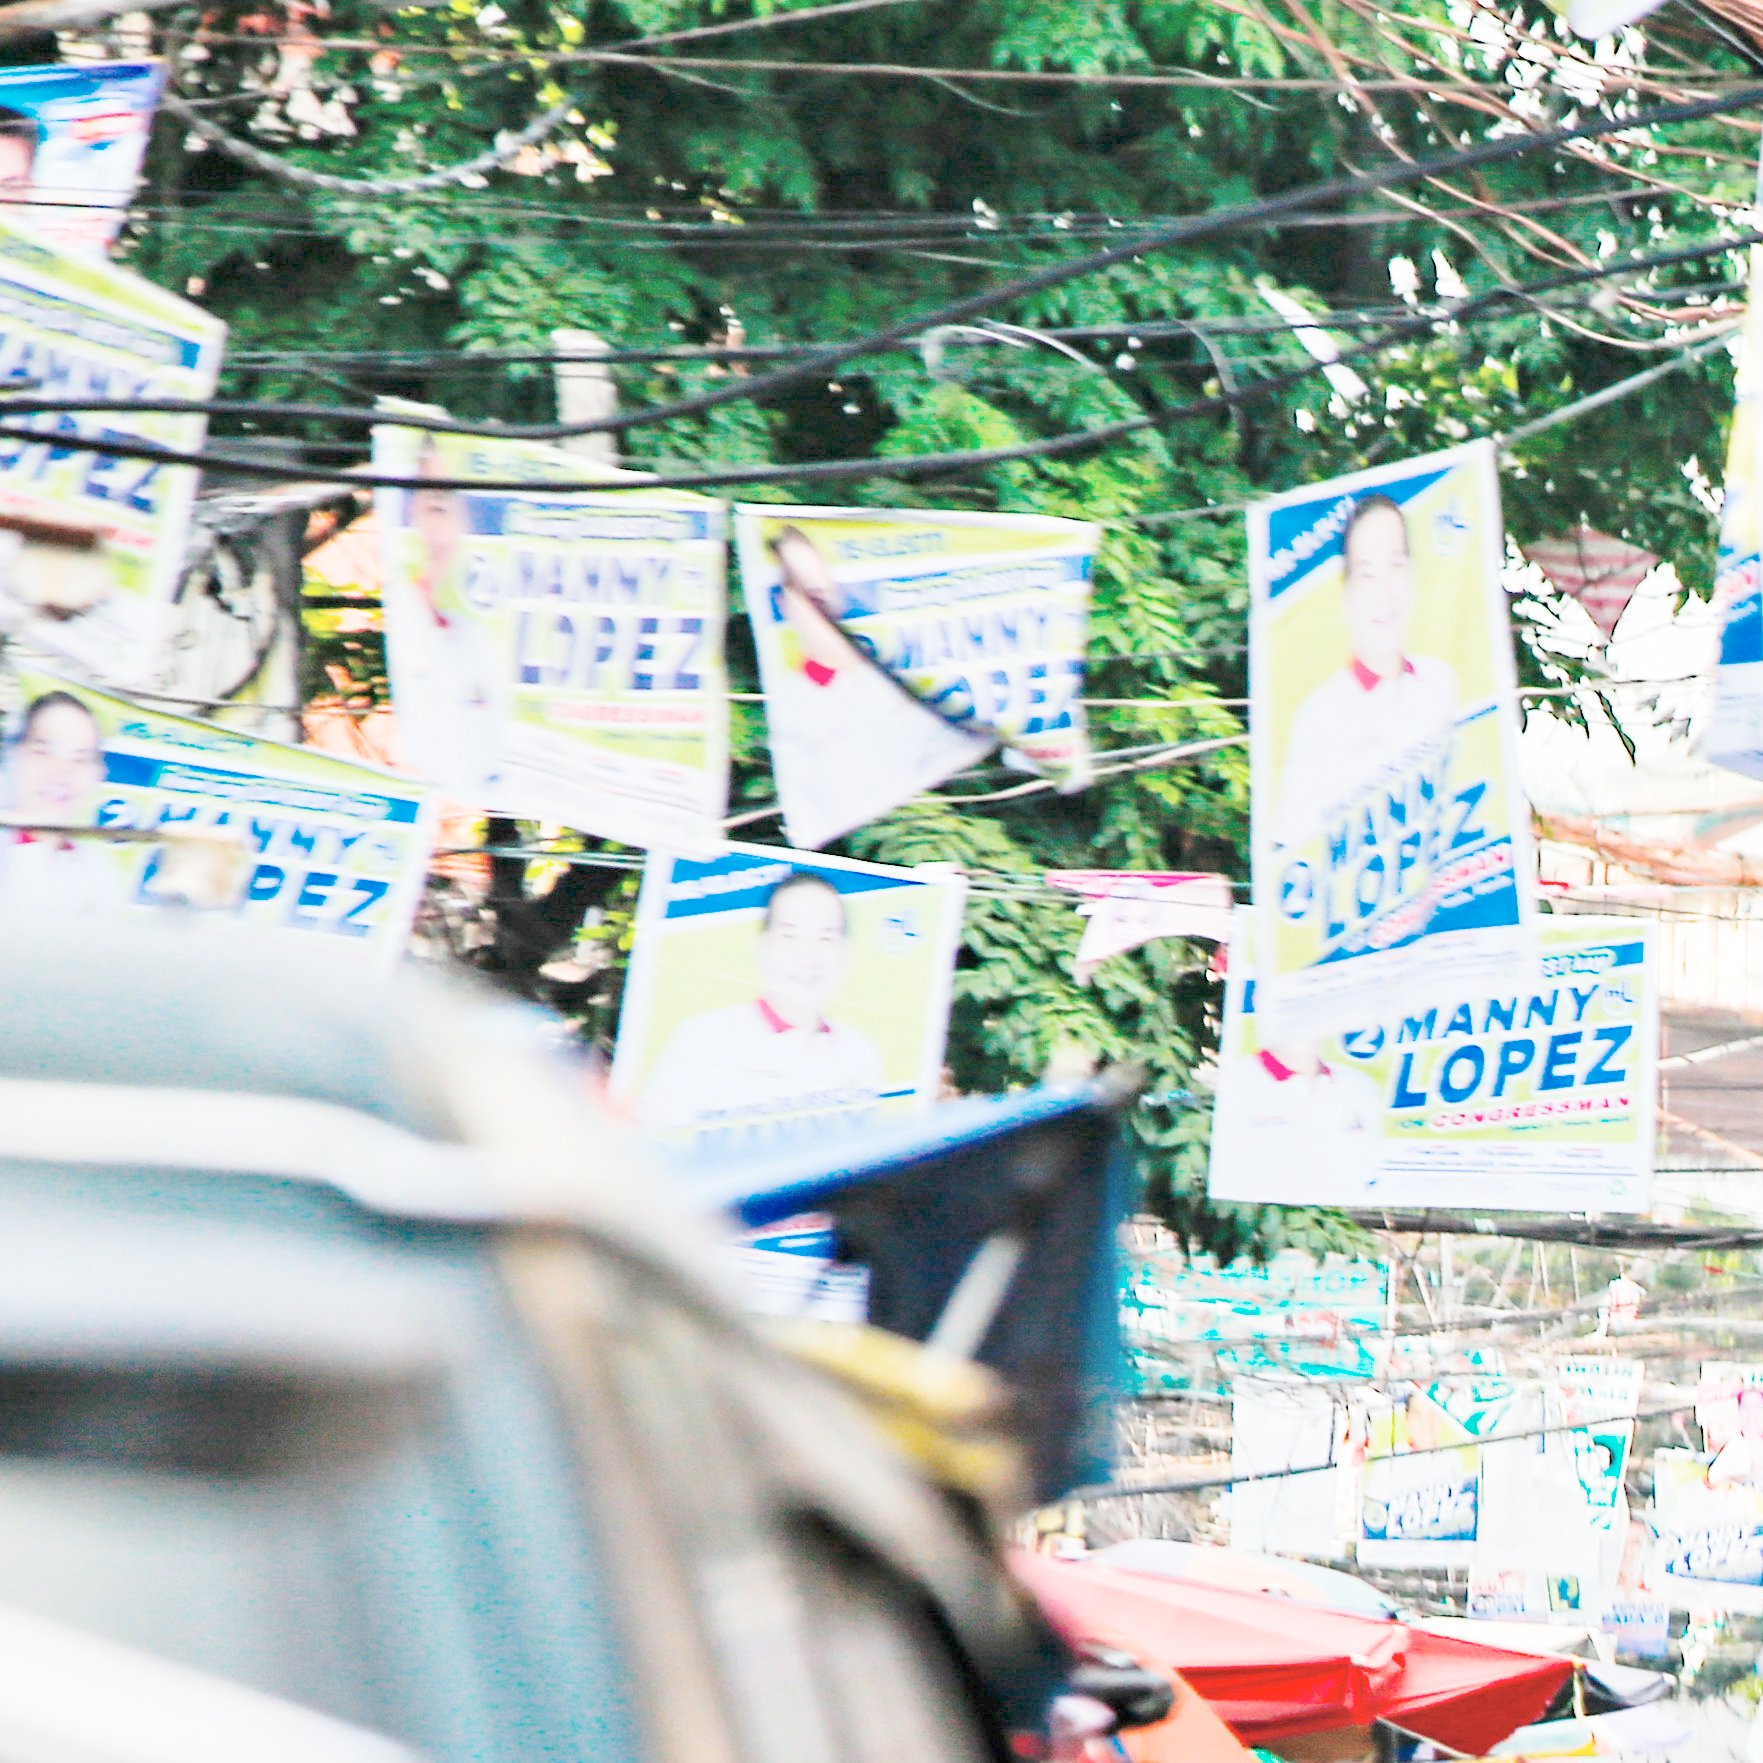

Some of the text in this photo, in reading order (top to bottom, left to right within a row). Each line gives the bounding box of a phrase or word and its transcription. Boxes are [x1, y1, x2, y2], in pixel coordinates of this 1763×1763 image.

[131, 846, 390, 938] LPEZ
[1396, 983, 1600, 1044] MANNY
[1390, 1025, 1634, 1109] LOPEZ
[1432, 1096, 1631, 1128] CONGRESSMAN
